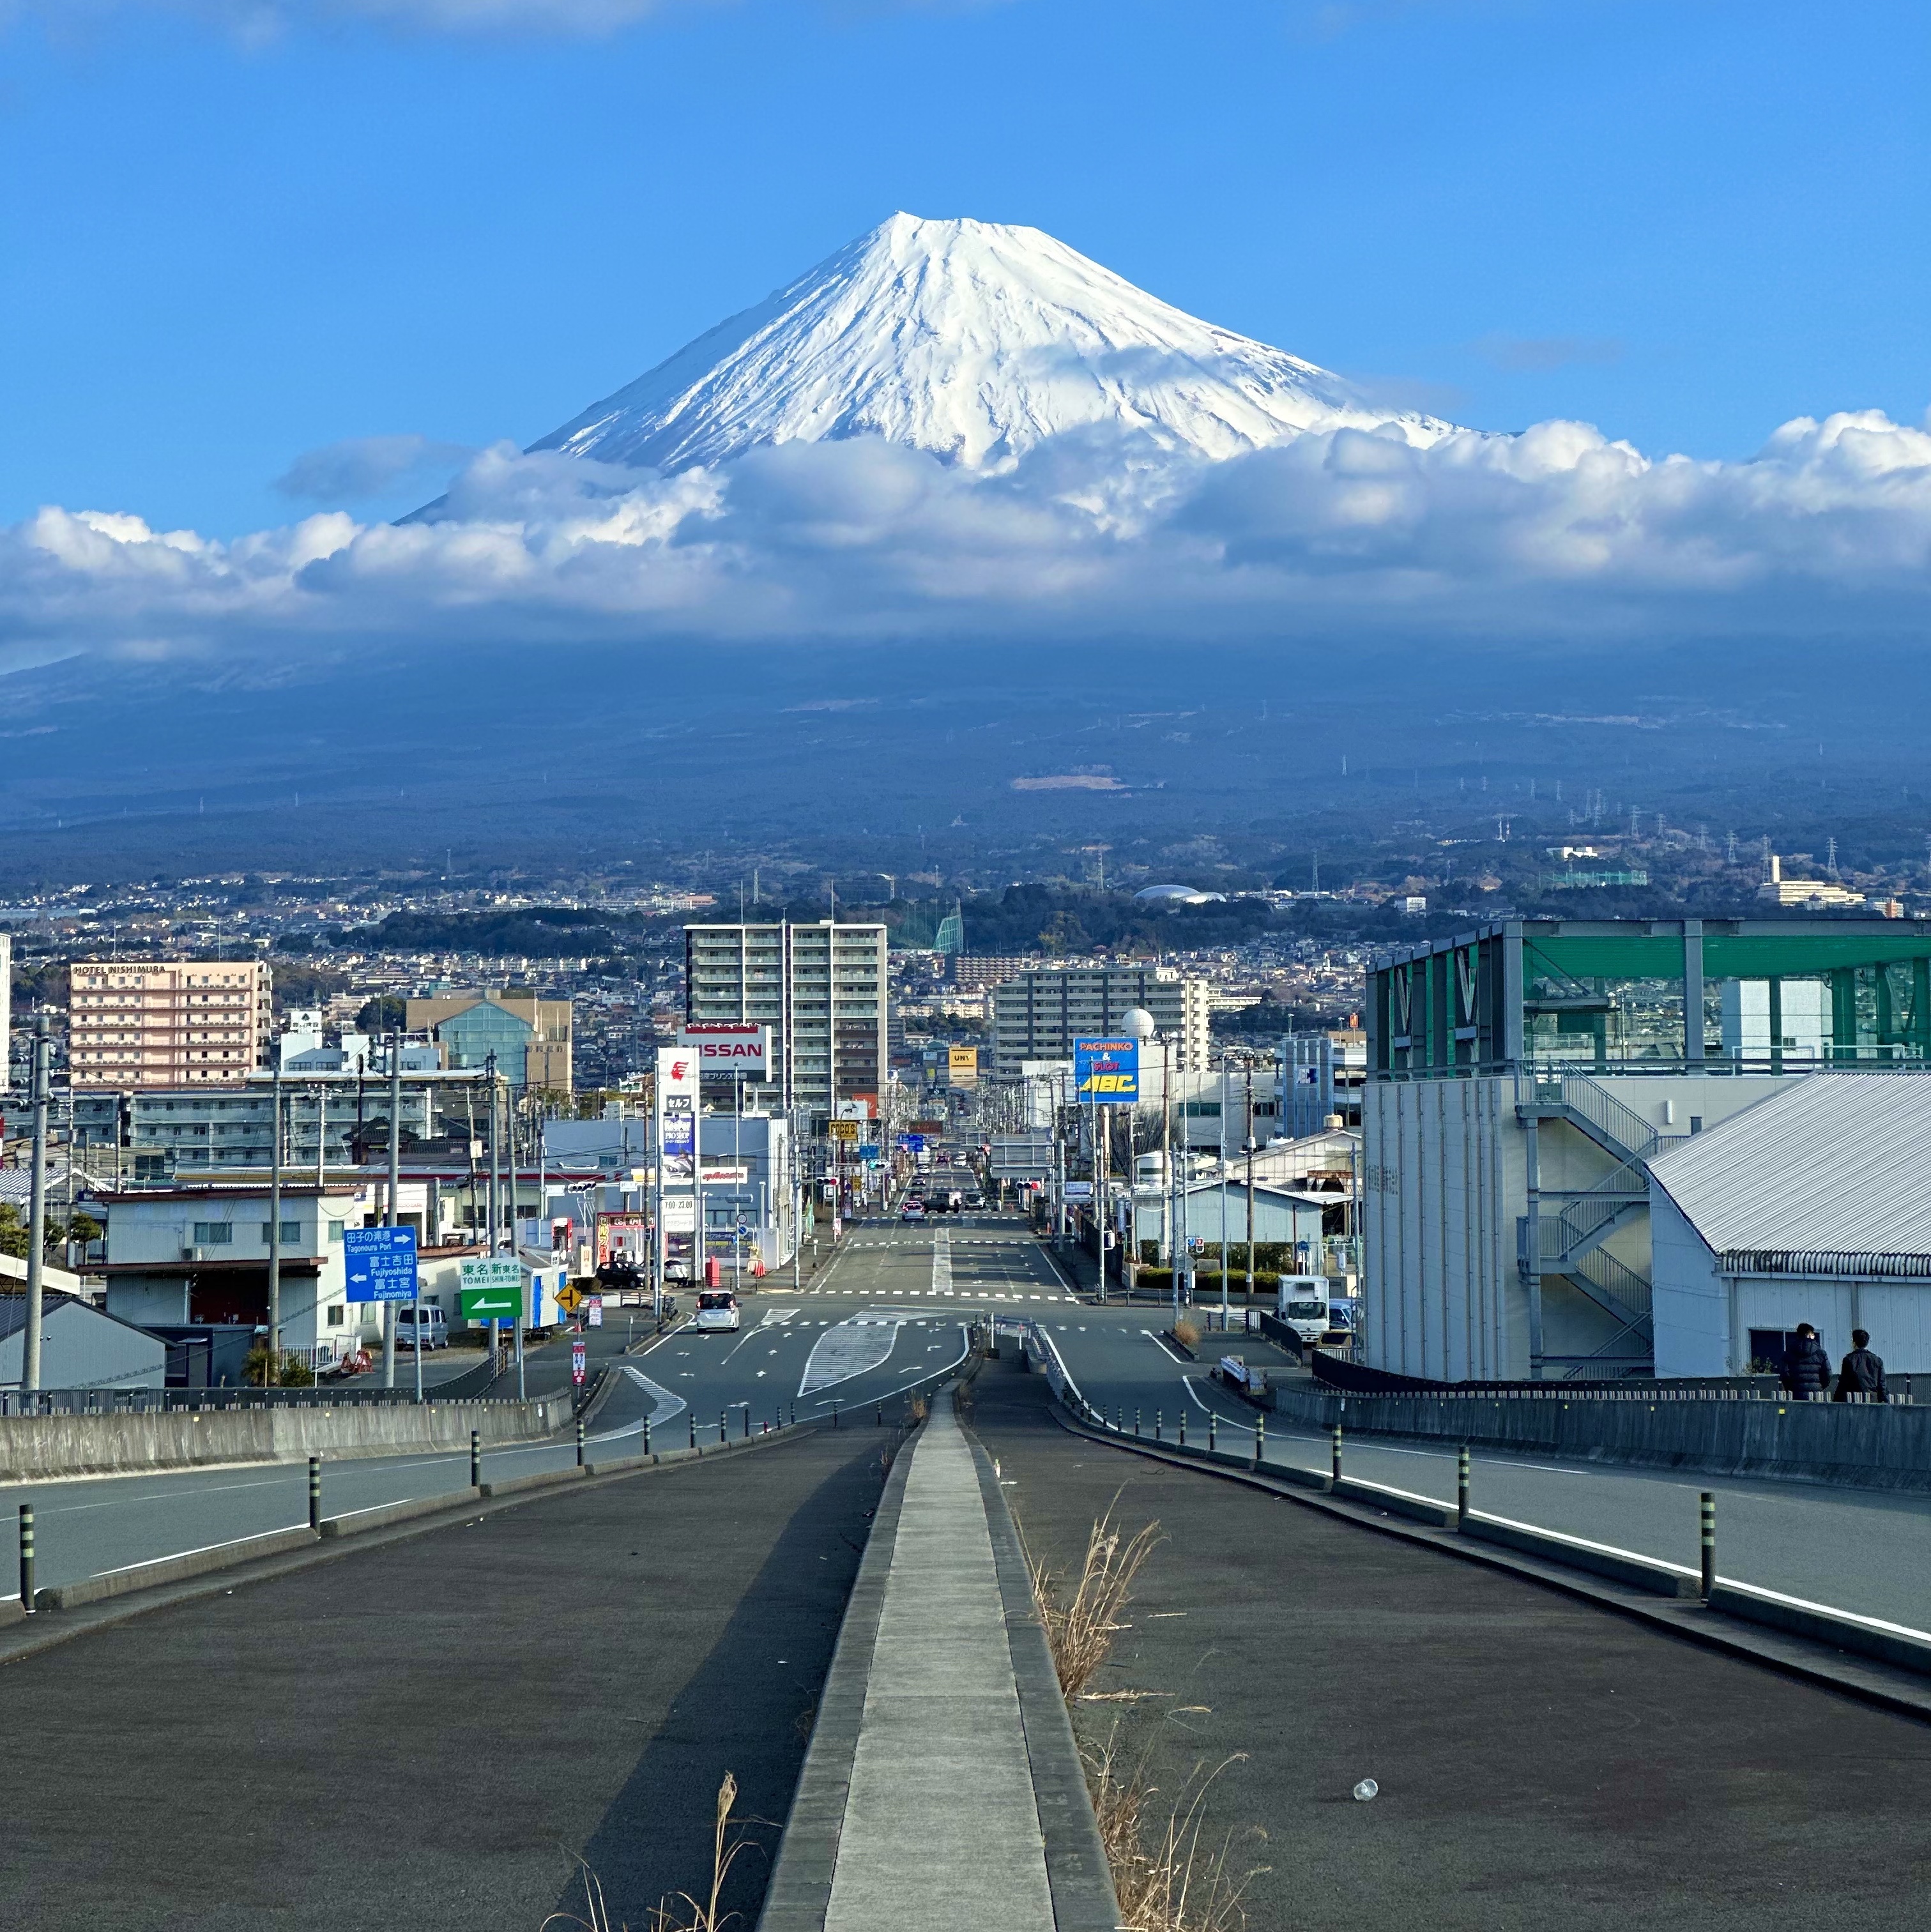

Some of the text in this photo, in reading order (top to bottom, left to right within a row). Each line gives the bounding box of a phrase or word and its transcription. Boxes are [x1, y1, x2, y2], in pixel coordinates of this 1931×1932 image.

[74, 965, 166, 975] HOTEL NISHIMURA
[682, 1044, 762, 1057] ISSAN
[1080, 1042, 1133, 1051] PACHINKO
[1103, 1052, 1111, 1060] &
[1094, 1062, 1120, 1071] SLOT
[1080, 1075, 1136, 1092] ABC
[668, 1099, 690, 1108] セルフ
[830, 1123, 855, 1134] COCO'S
[347, 1245, 378, 1253] Tagonoura
[369, 1254, 414, 1268] 富士吉田
[370, 1267, 413, 1277] Fujiyoshida
[462, 1263, 488, 1275] 東名
[491, 1263, 519, 1274] 新東名
[374, 1277, 411, 1289] 富士宮
[492, 1275, 519, 1283] SHIN-TOMEI
[374, 1289, 412, 1300] Fujinomiya
